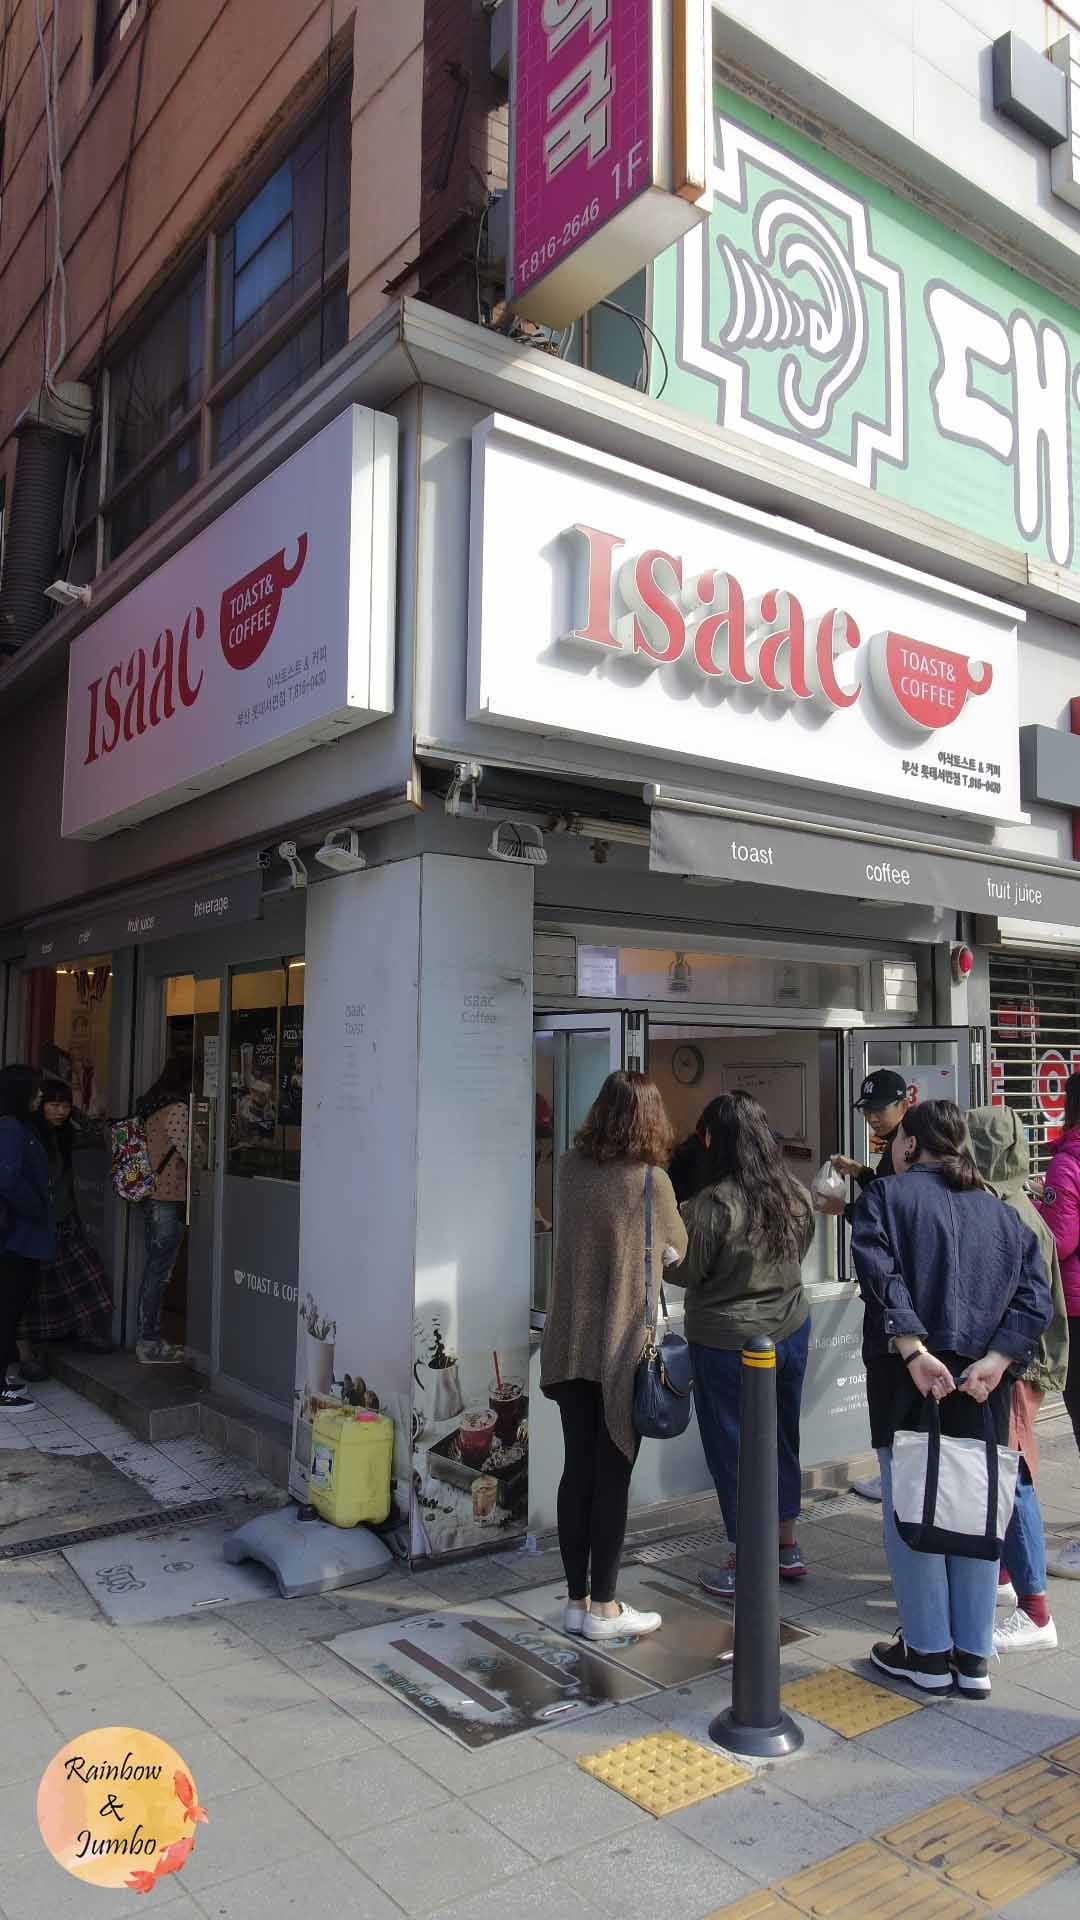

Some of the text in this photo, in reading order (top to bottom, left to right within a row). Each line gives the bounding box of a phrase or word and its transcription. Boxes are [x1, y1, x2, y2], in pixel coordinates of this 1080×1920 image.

[611, 139, 643, 200] 1F
[519, 197, 600, 283] T.816-2646
[924, 279, 1080, 566] 대
[229, 573, 274, 620] TOAST&
[573, 523, 862, 708] Isaac
[228, 603, 272, 649] COFFEE
[84, 606, 205, 766] Isaac
[901, 649, 956, 682] TOAST&
[900, 676, 955, 708] COFFEE
[901, 760, 919, 777] 부산
[938, 751, 977, 771] 이삭토스트
[731, 841, 1043, 905] toast coffee fruit juice
[193, 896, 229, 918] beverage
[247, 1272, 299, 1303] TOAST & COF
[848, 1374, 867, 1386] TOAS
